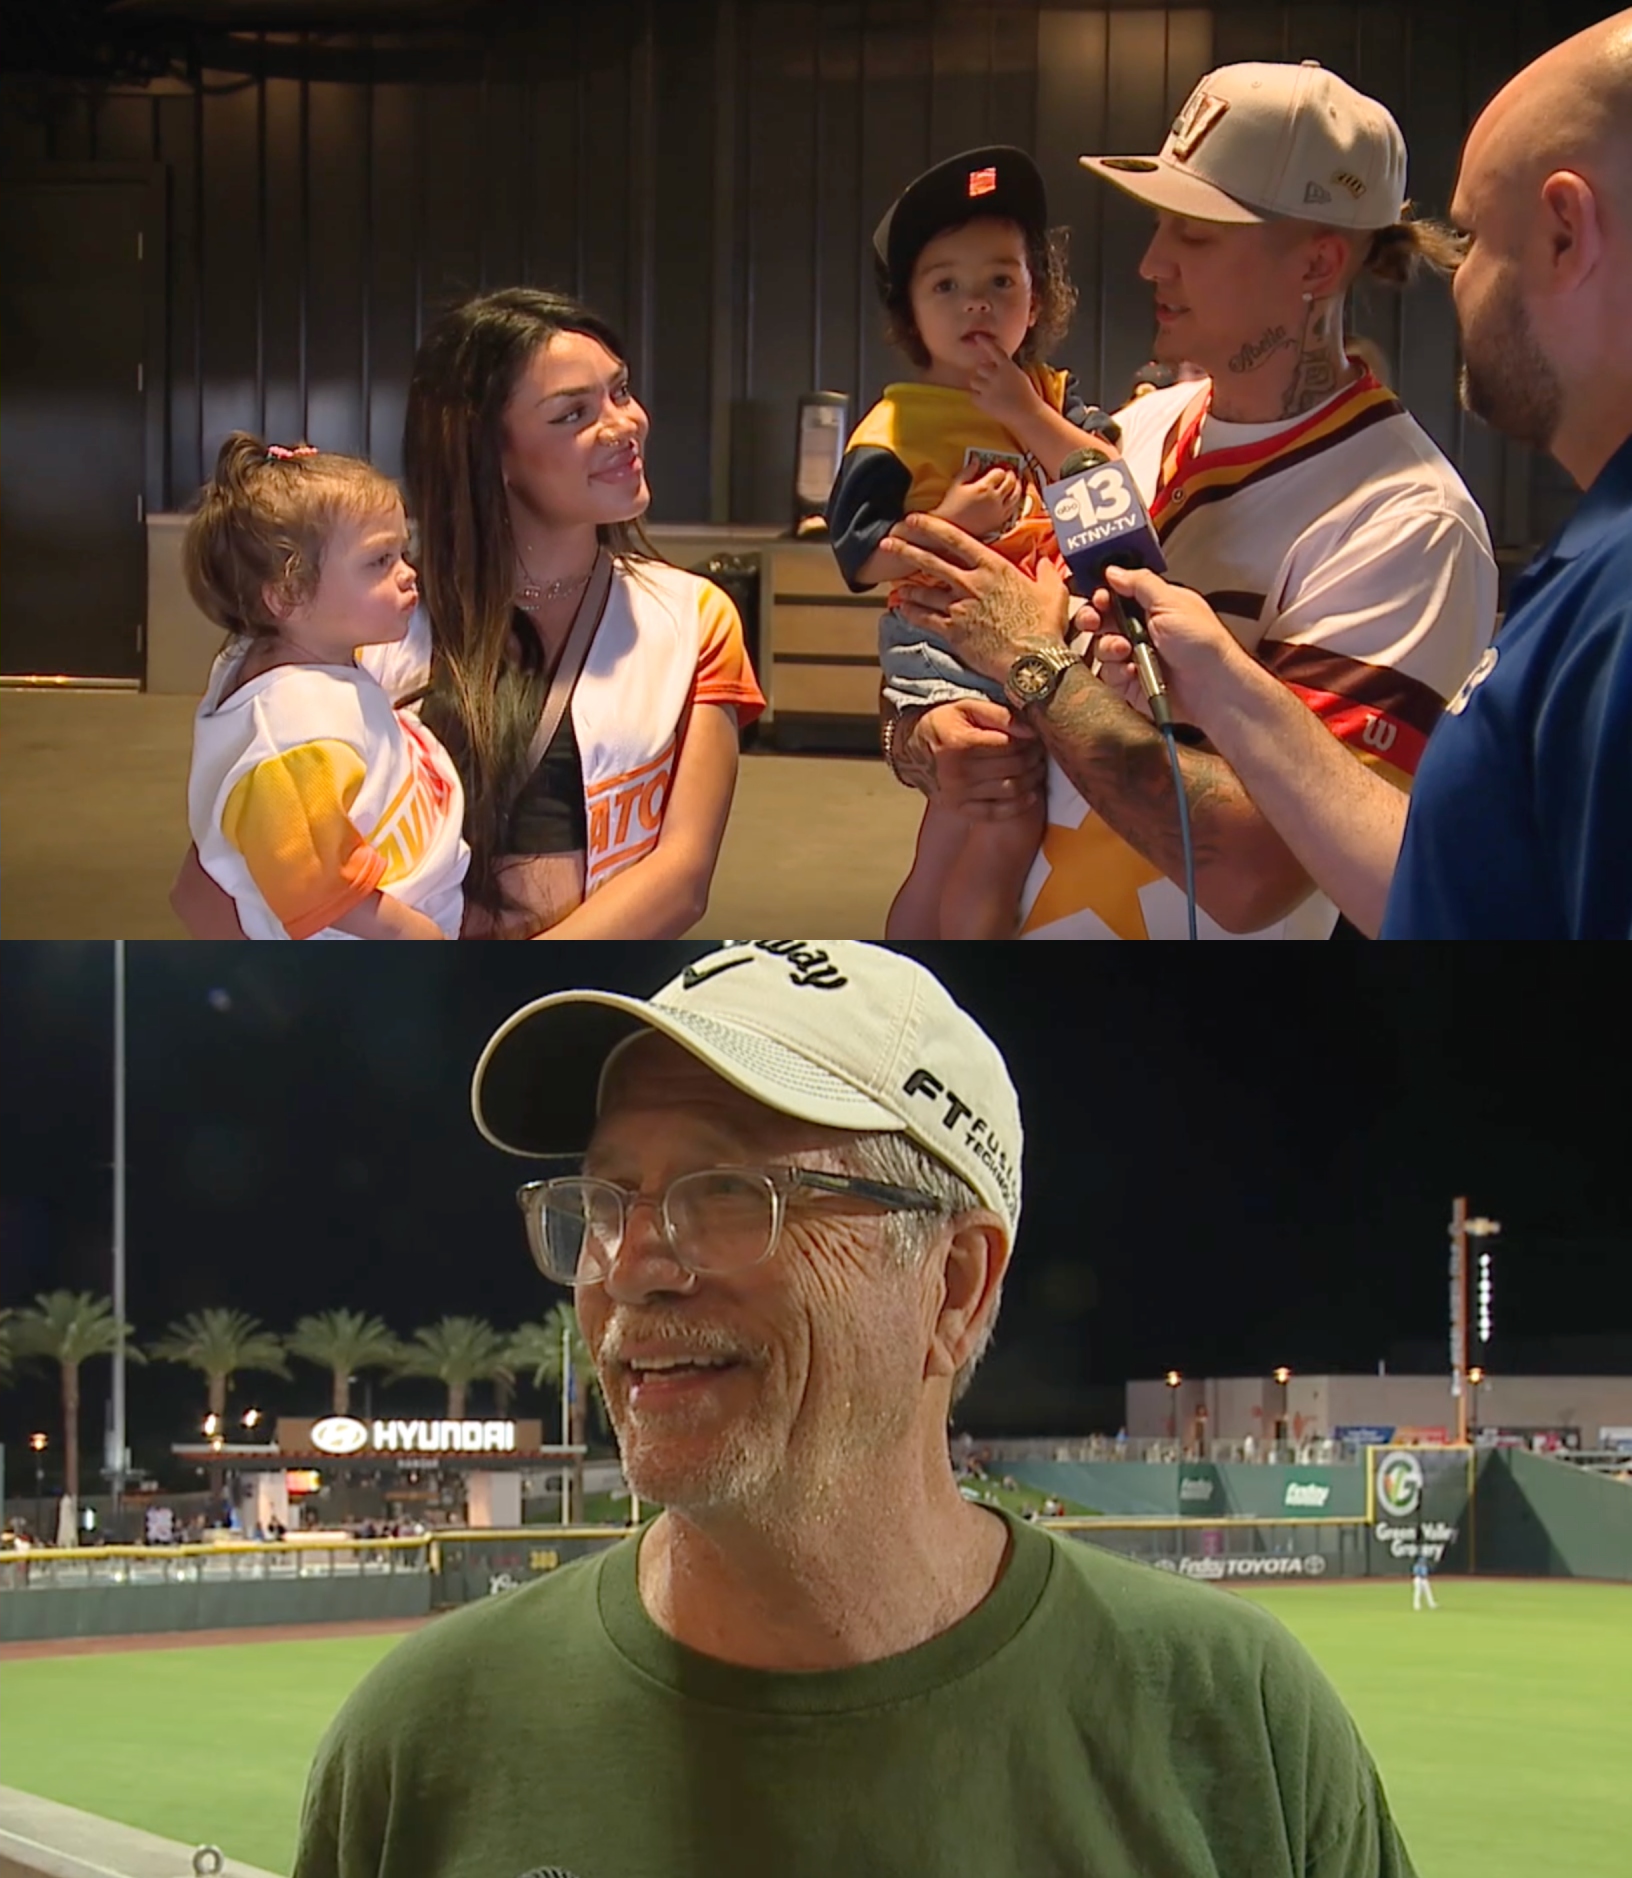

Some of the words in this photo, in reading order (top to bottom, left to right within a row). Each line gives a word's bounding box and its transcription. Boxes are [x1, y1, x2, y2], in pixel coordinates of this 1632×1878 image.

[1056, 501, 1079, 516] abc
[1067, 467, 1132, 529] 13
[1067, 513, 1137, 550] KTNV-TV
[902, 1068, 973, 1131] FT
[971, 1117, 1018, 1200] FUSI
[372, 1419, 516, 1451] HYUNDAI
[1375, 1522, 1418, 1541] Green
[1421, 1522, 1460, 1545] Valley
[1226, 1559, 1303, 1575] TOYOTA
